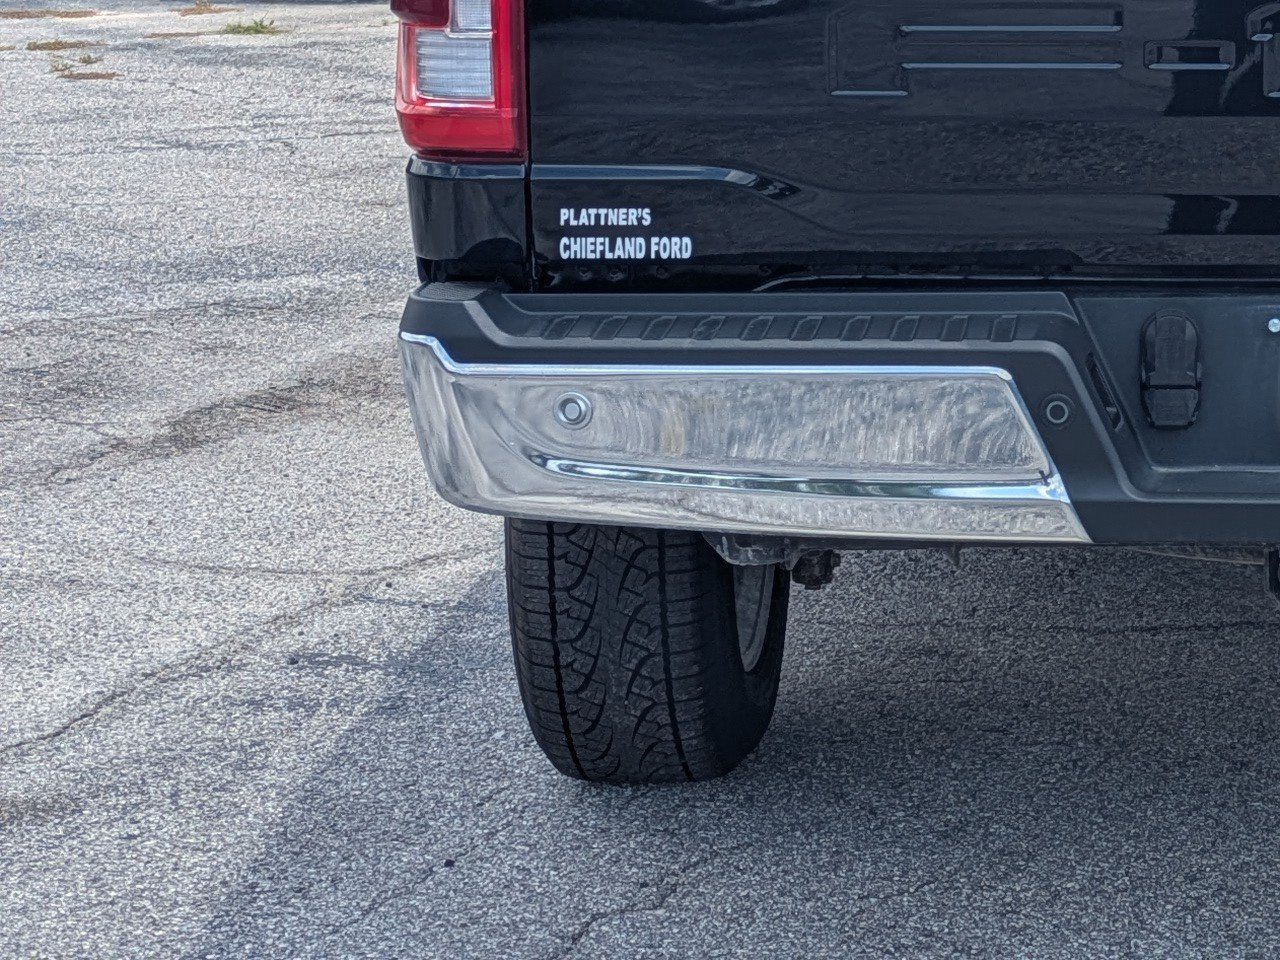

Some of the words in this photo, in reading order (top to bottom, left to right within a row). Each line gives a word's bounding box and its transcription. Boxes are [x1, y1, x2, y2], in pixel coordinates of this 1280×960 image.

[560, 208, 651, 226] PLATTNER'S
[559, 236, 646, 260] CHIEFLAND
[650, 236, 692, 260] FORD
